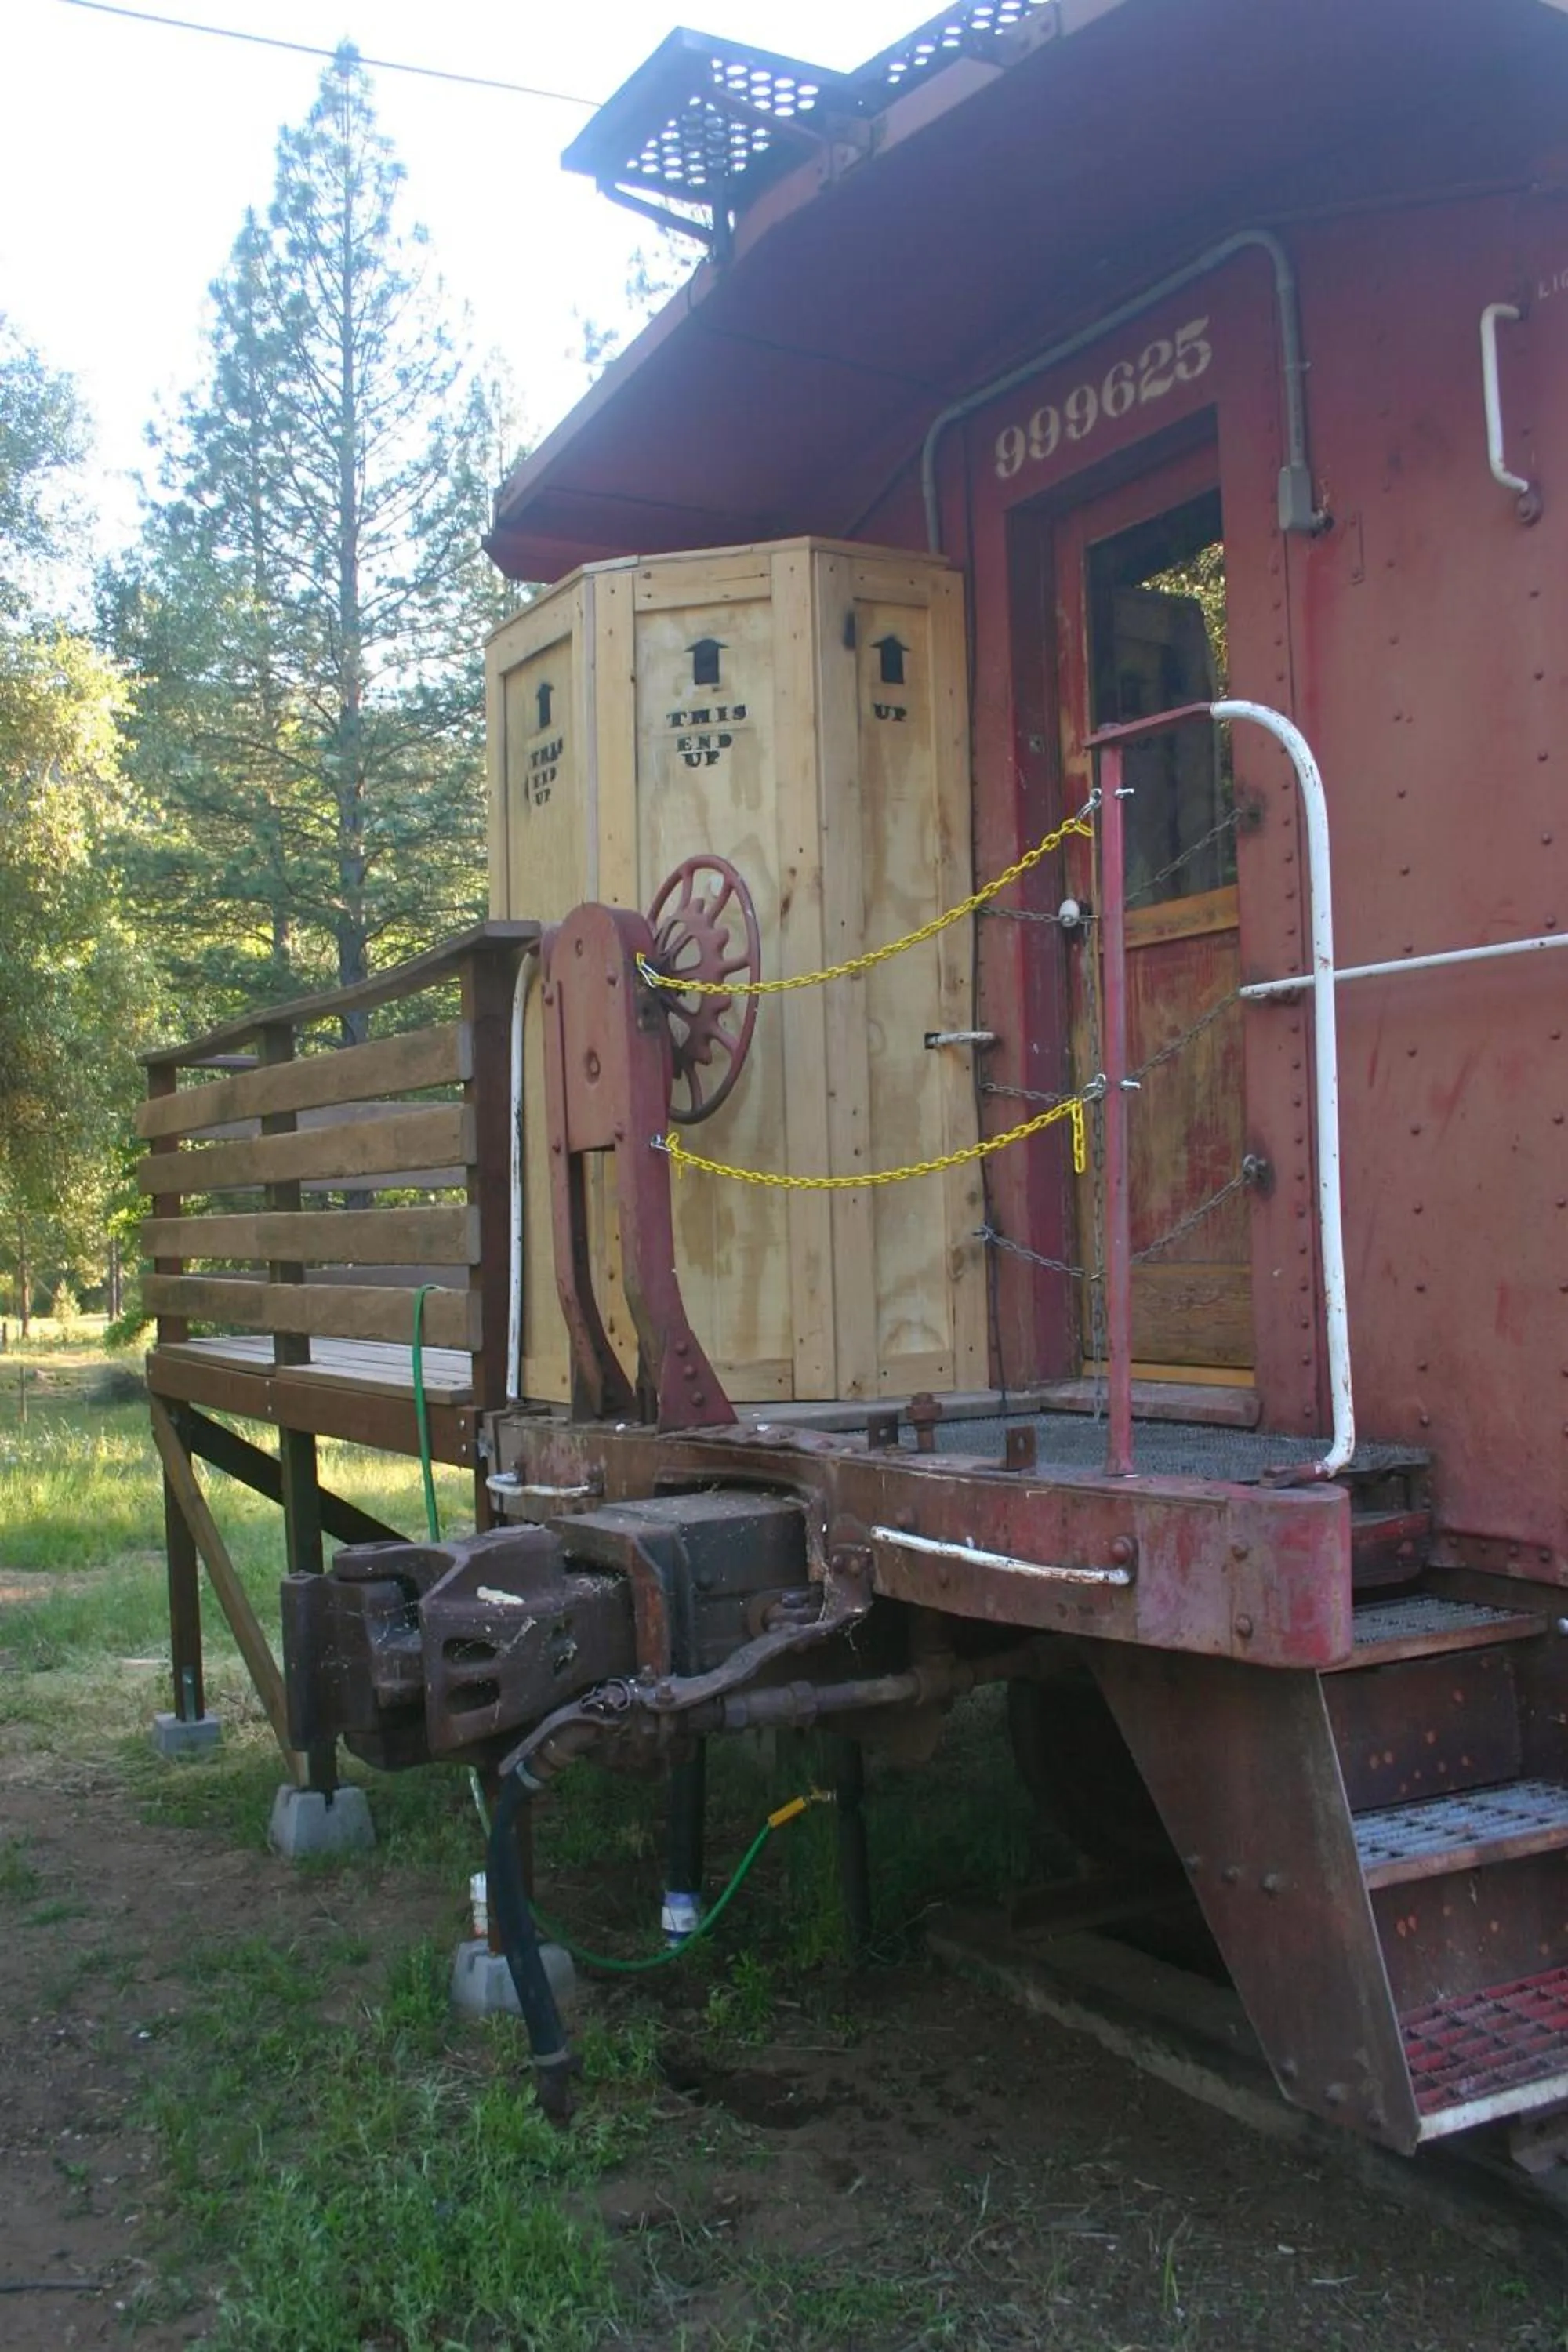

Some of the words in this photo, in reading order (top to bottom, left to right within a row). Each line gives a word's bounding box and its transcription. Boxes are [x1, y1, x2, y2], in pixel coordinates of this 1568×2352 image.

[993, 314, 1213, 479] 999625
[666, 704, 747, 728] THIS
[873, 703, 907, 722] UP
[677, 733, 732, 753] END
[682, 750, 720, 768] UP
